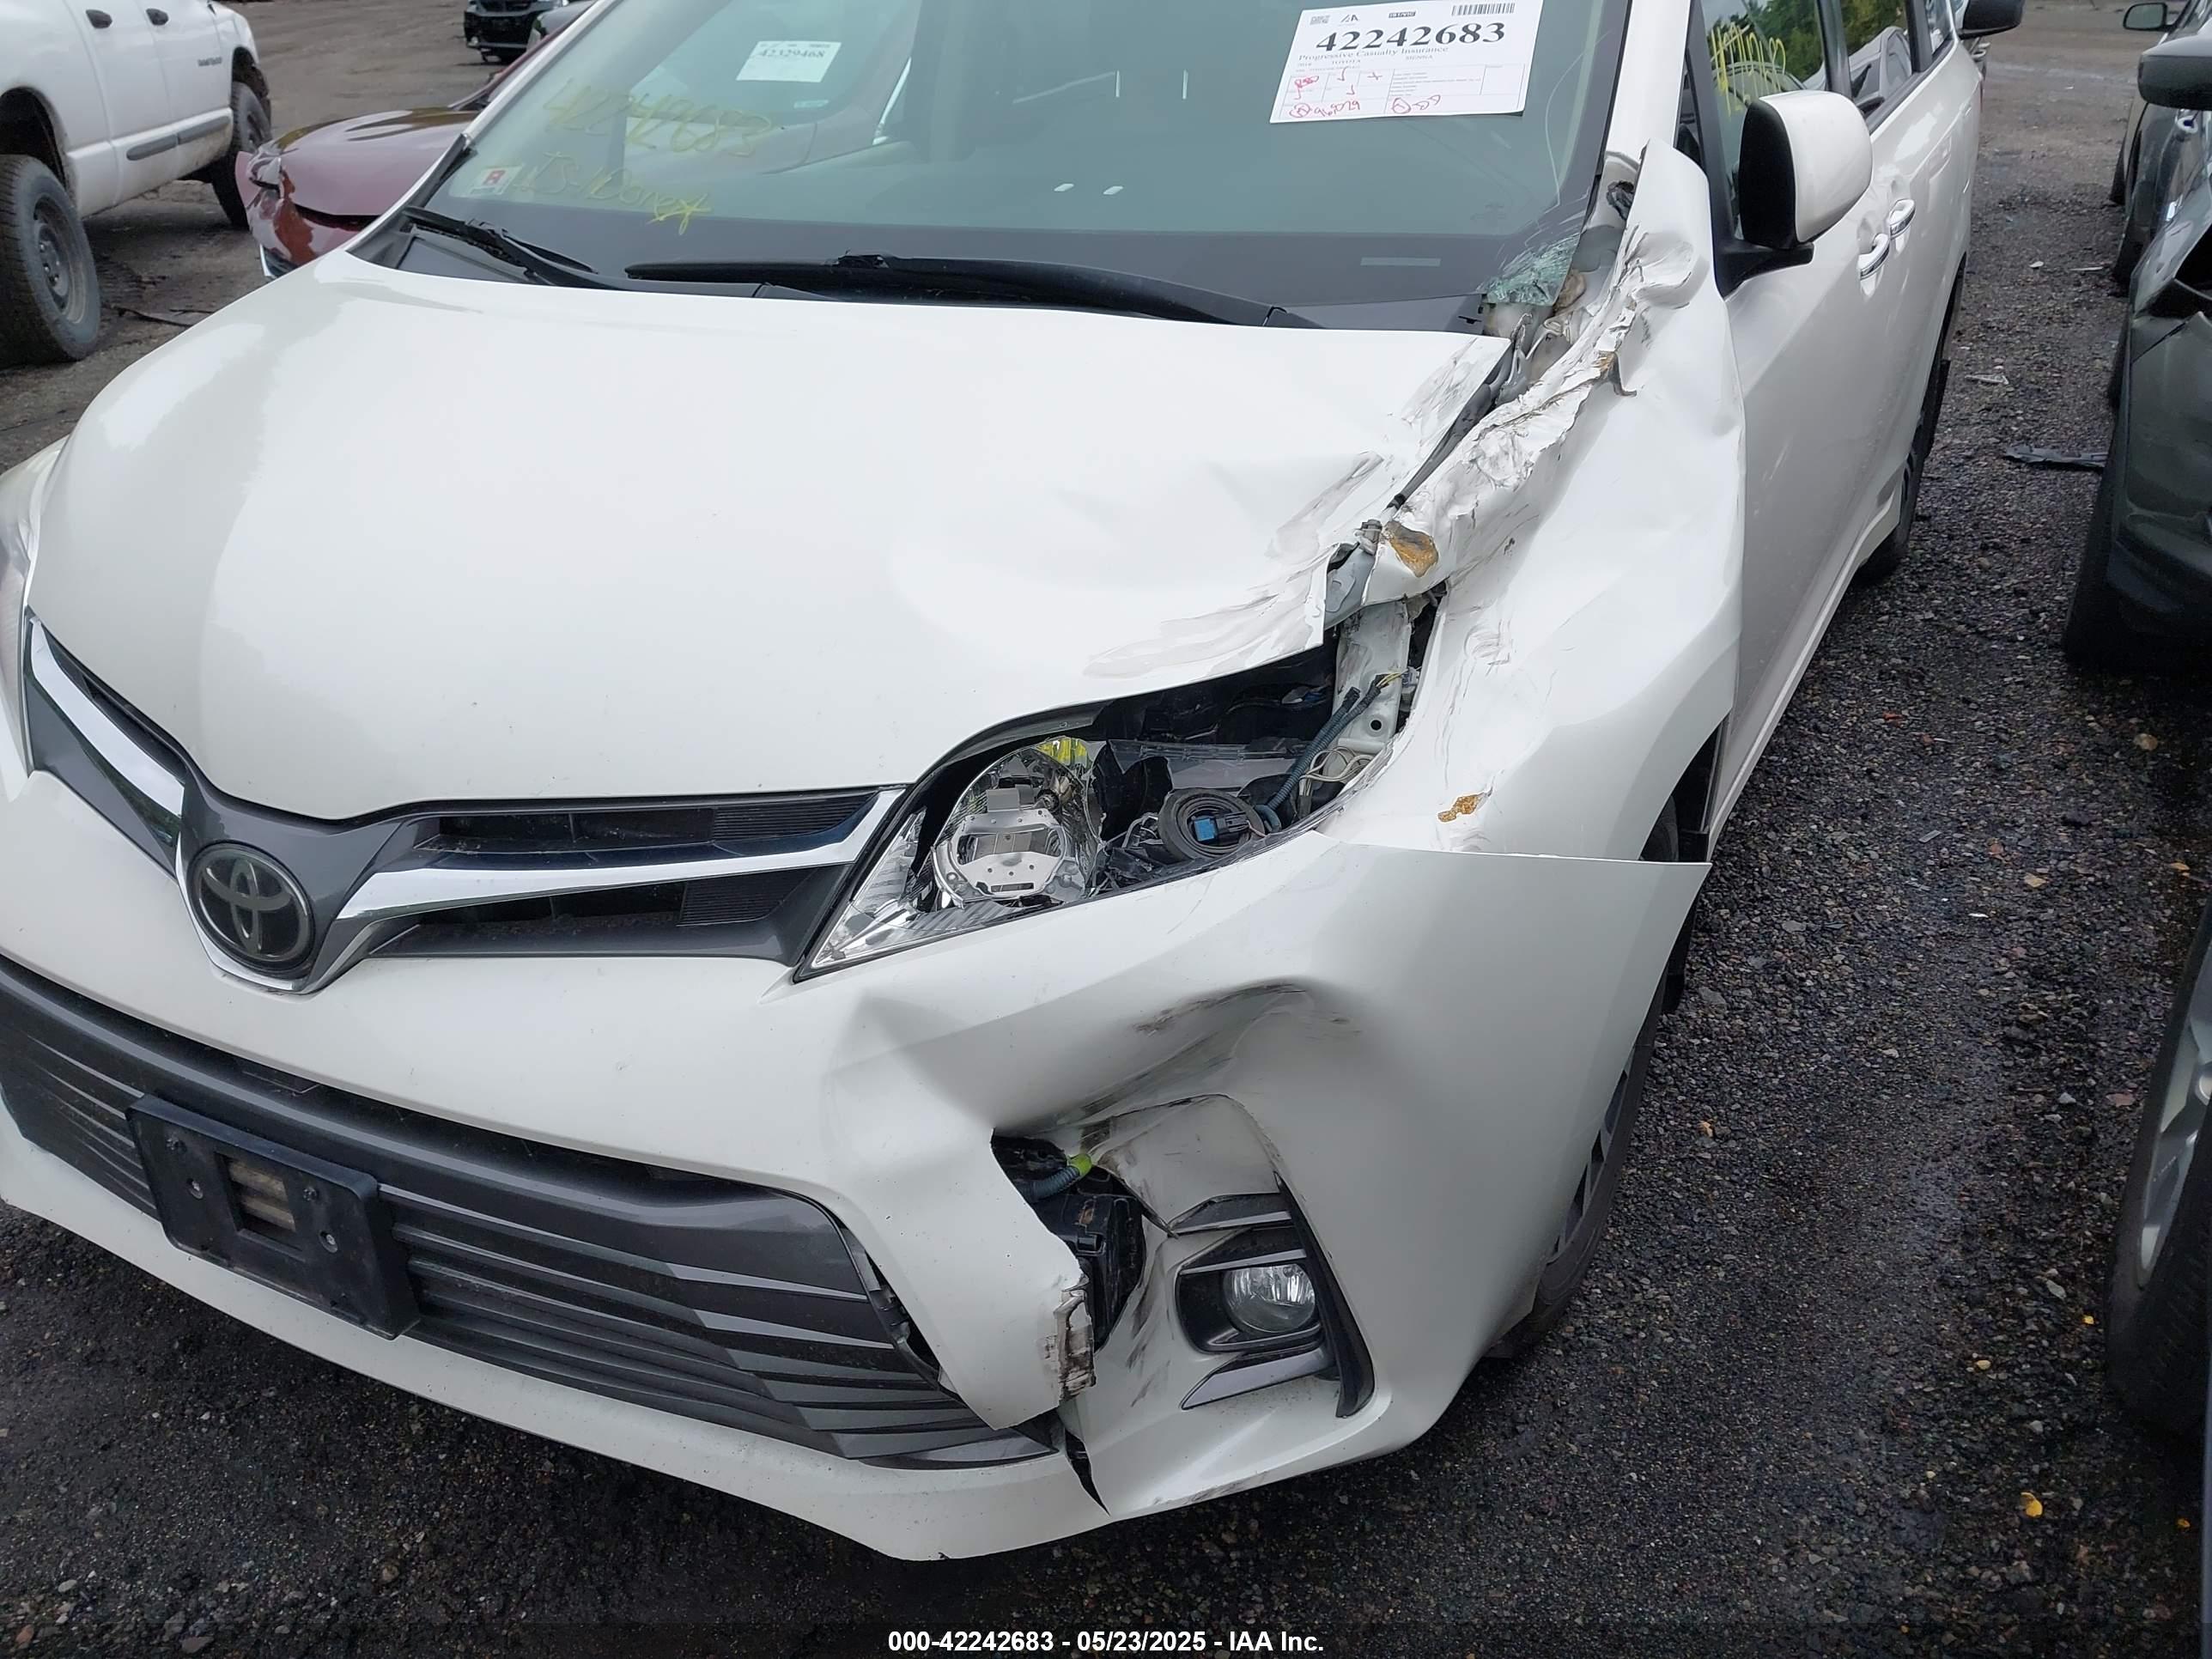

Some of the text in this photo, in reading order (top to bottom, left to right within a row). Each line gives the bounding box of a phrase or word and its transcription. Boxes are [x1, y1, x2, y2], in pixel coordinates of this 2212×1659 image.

[1316, 22, 1504, 52] 42242683
[1298, 52, 1354, 61] Progressive
[1356, 47, 1398, 58] Casualty
